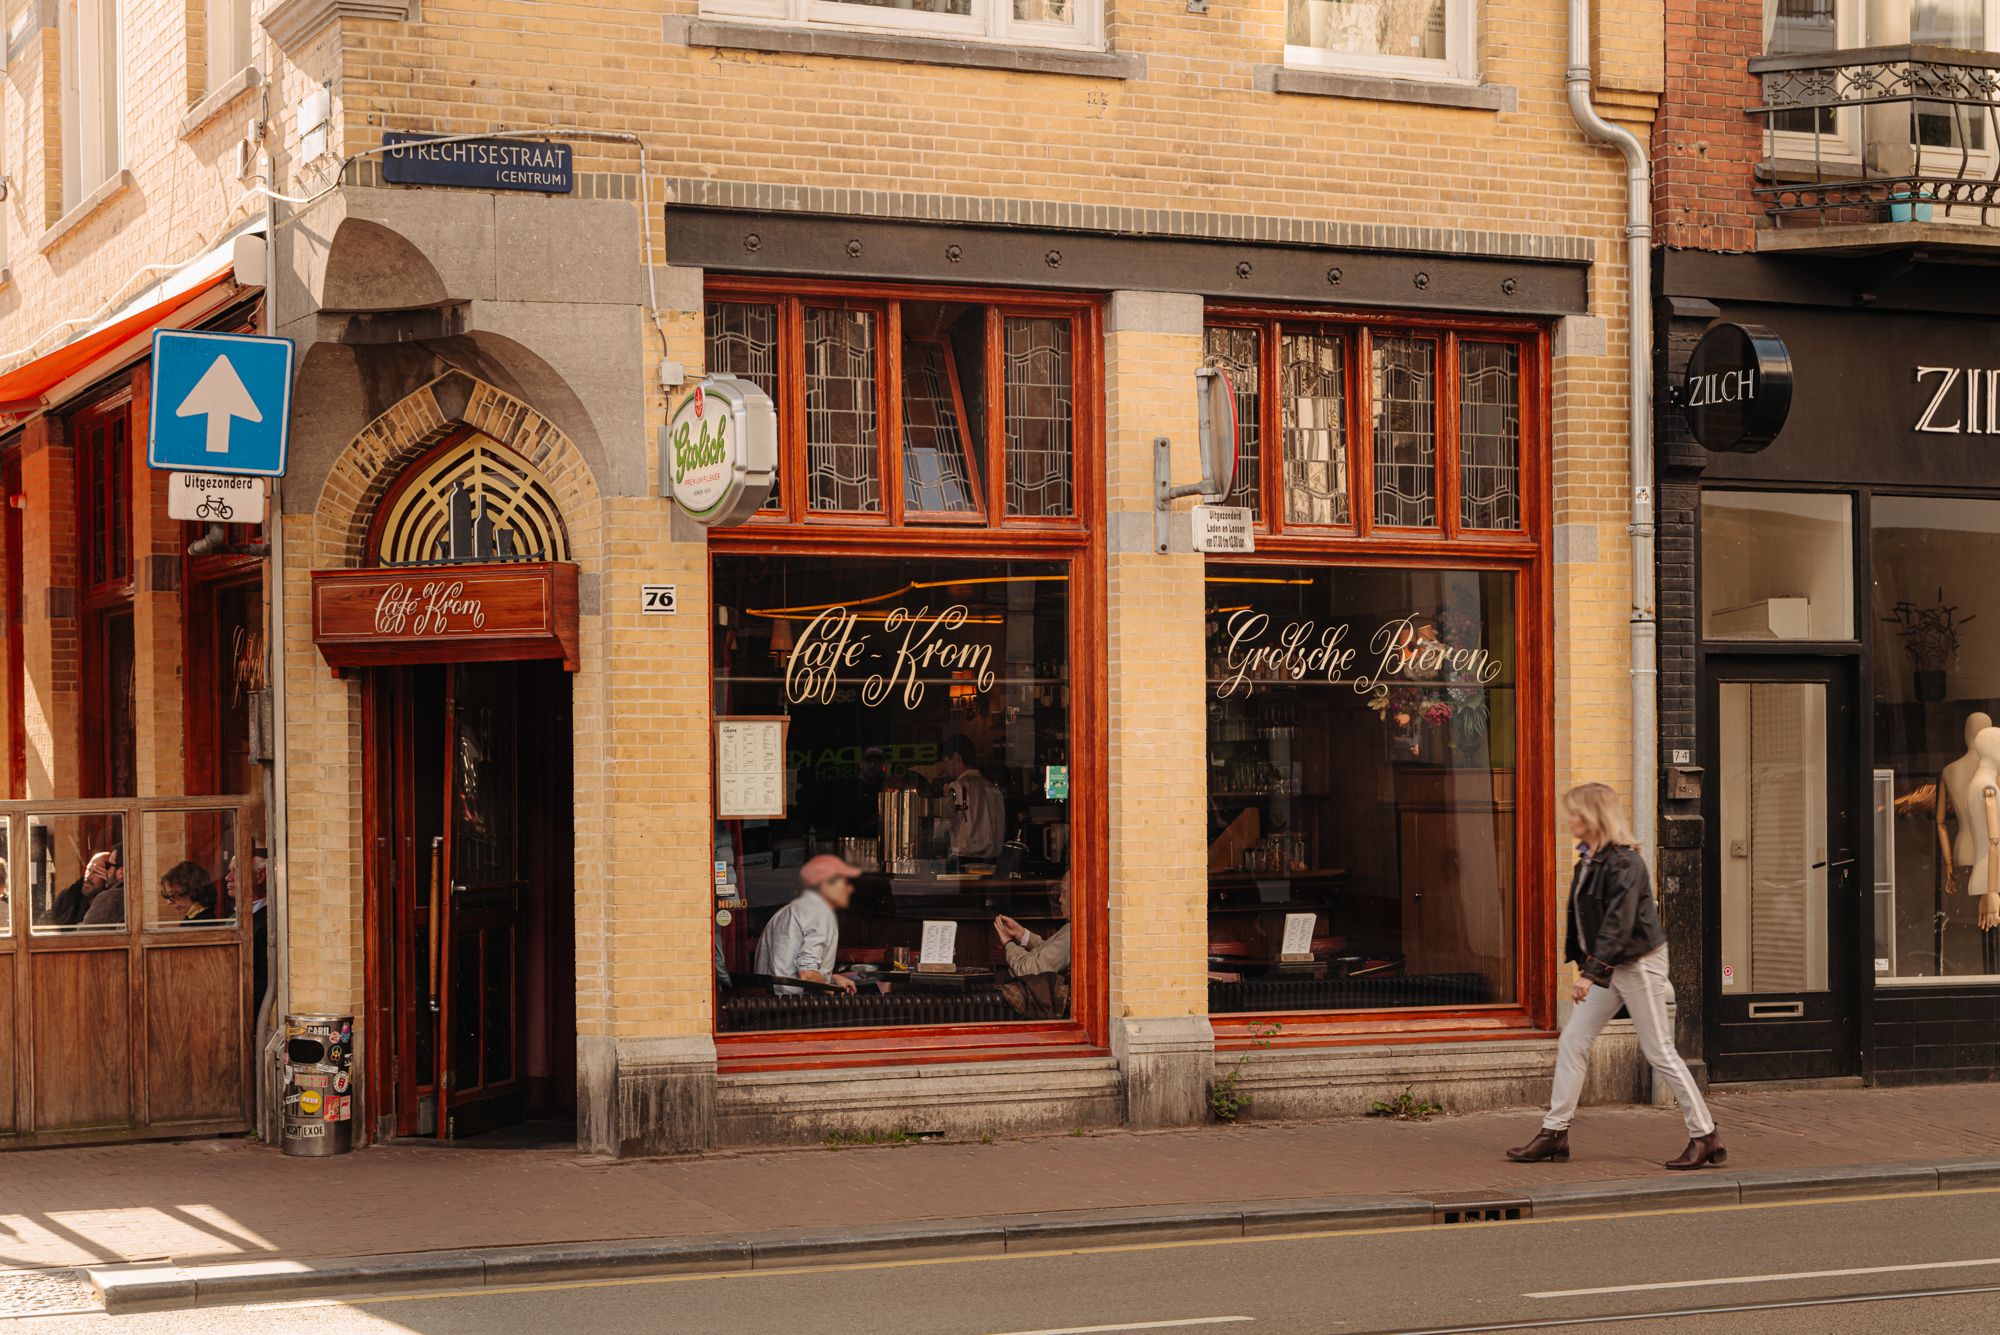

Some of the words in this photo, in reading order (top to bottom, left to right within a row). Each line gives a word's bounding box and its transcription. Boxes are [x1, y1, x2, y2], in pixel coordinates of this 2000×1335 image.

[391, 139, 566, 169] UTRECHTSESTRAAT
[496, 170, 567, 186] (CENTRUM)
[1688, 368, 1755, 407] ZILCH
[674, 414, 727, 484] Grolsch
[184, 474, 253, 491] Uitgezonderd
[1209, 510, 1242, 522] Uitgezonderd
[1206, 523, 1221, 533] Laden
[1222, 525, 1229, 533] en
[1229, 523, 1246, 534] Lossen
[375, 582, 422, 634] Café
[413, 581, 485, 636] Krom
[645, 592, 674, 607] 76
[785, 605, 871, 706] Café
[862, 604, 996, 711] Krom
[1216, 609, 1357, 699] Grolsche
[1353, 612, 1502, 698] Bieren
[1674, 751, 1688, 761] 74
